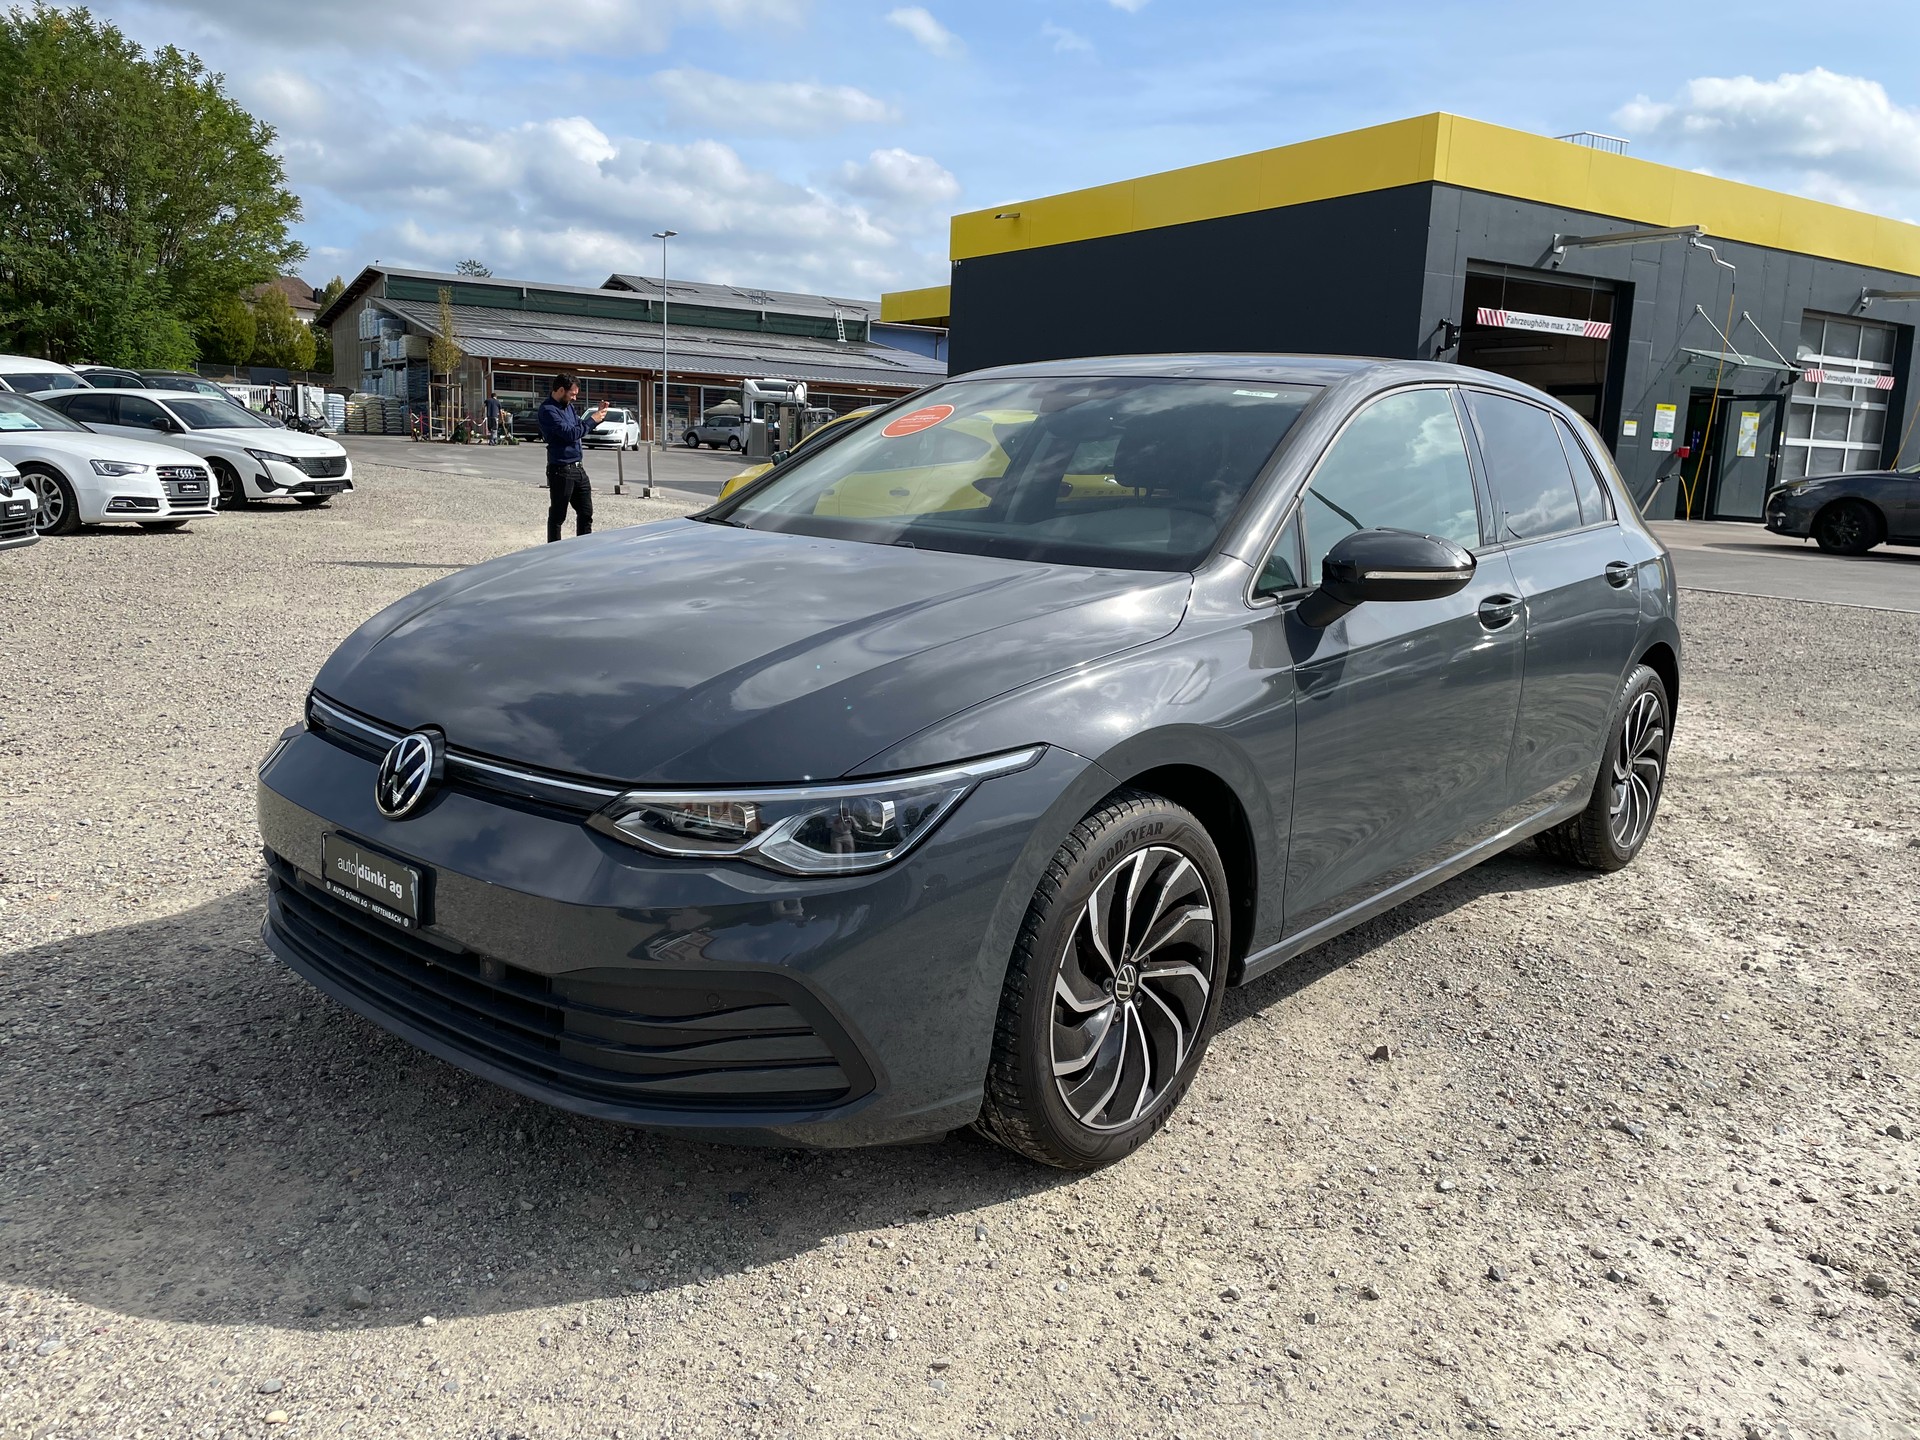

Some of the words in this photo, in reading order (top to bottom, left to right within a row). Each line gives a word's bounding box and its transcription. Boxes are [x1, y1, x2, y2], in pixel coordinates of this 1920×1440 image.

[1506, 315, 1550, 330] Fahrzeughöhe
[1551, 323, 1565, 331] max.
[1088, 821, 1164, 882] GOODYEAR
[358, 864, 387, 889] dünki
[389, 880, 403, 899] ag
[333, 885, 345, 897] AUTO
[345, 891, 360, 905] DÜNKI
[360, 899, 368, 908] AG
[371, 903, 402, 924] NEFTENBACH
